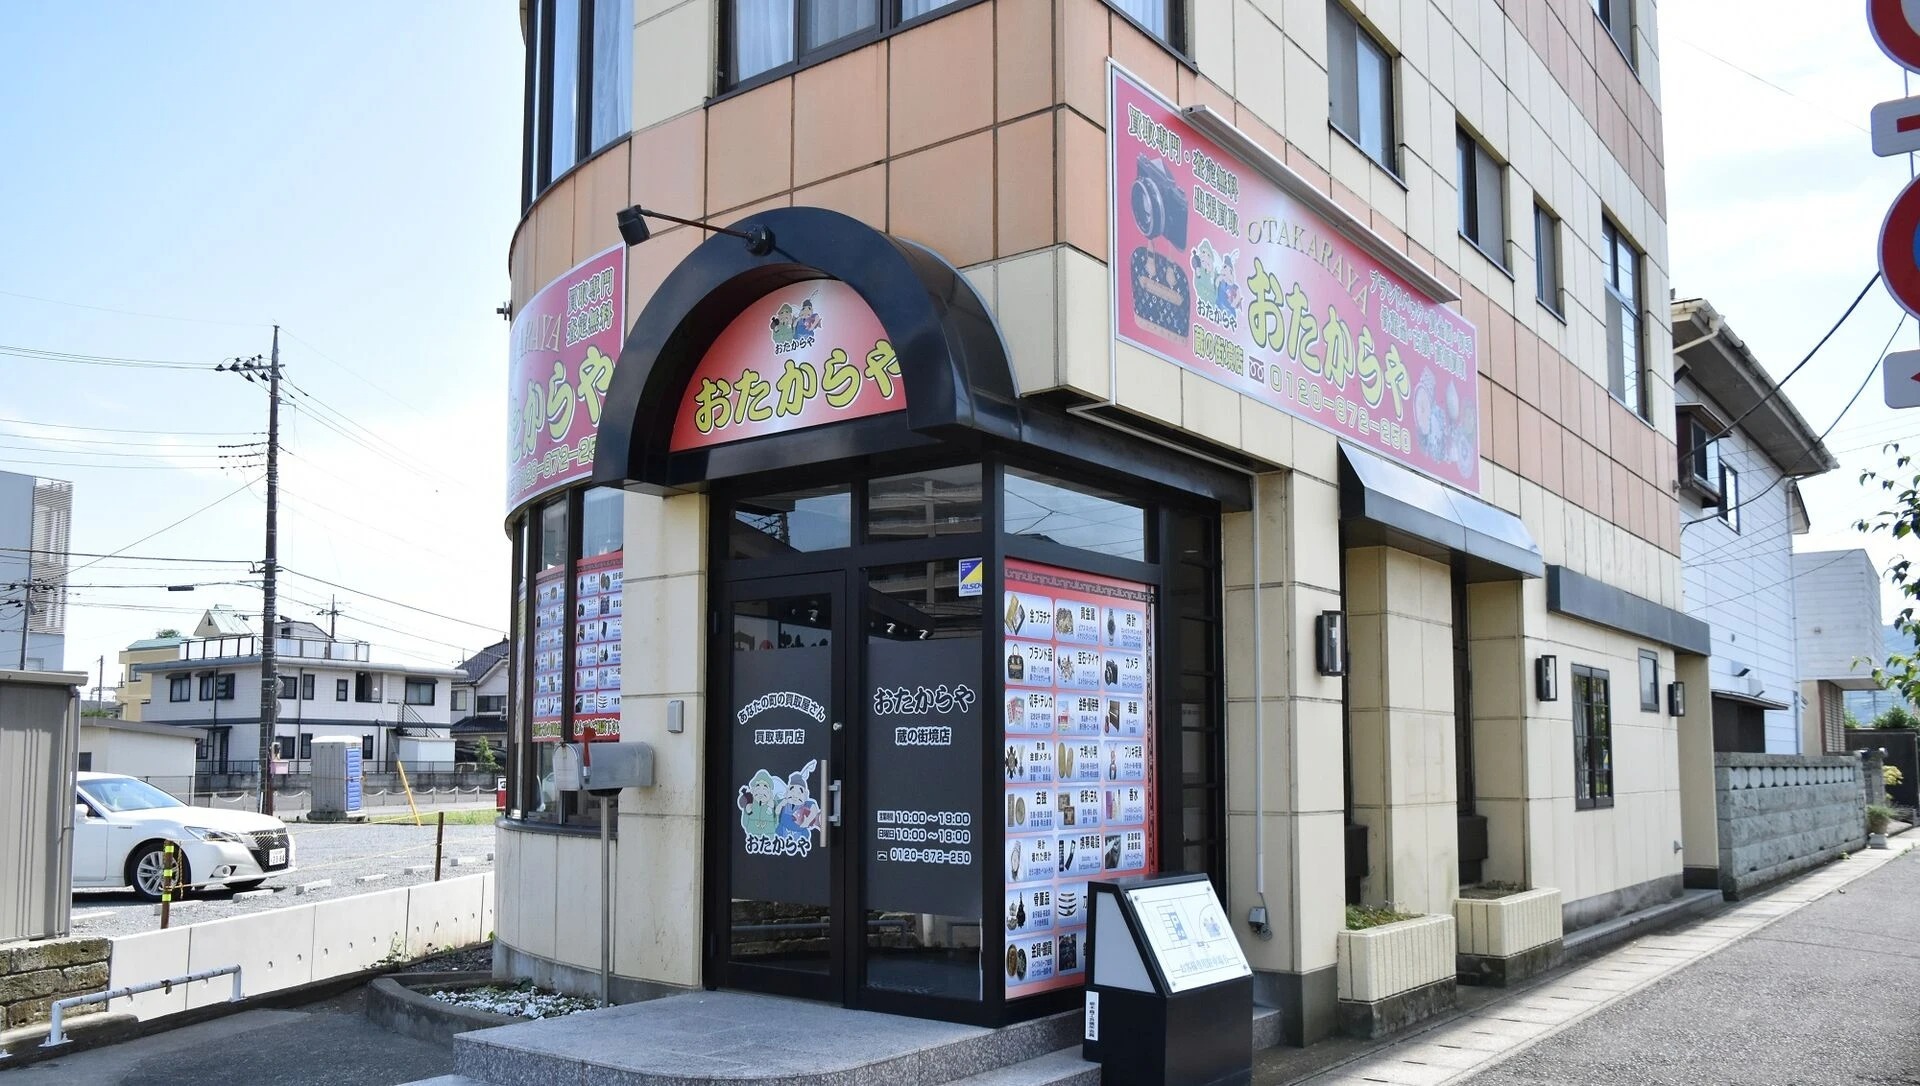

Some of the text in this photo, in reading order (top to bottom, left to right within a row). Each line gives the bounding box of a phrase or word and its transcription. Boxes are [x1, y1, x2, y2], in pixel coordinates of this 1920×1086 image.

[1248, 219, 1369, 318] OTAKARAYA
[568, 267, 613, 315] 買取専門
[566, 300, 613, 346] 査定無料
[1197, 298, 1238, 333] おたからや
[775, 337, 815, 355] おたからや
[1247, 257, 1411, 421] おたからや
[695, 339, 902, 435] おたからや
[737, 692, 826, 724] あなたの町の買取屋さん
[873, 685, 975, 715] おたからや
[755, 729, 805, 744] 買取専門店
[895, 727, 951, 745] 蔵の街境店
[746, 834, 811, 857] おたからや
[890, 848, 971, 864] 0120-872-250
